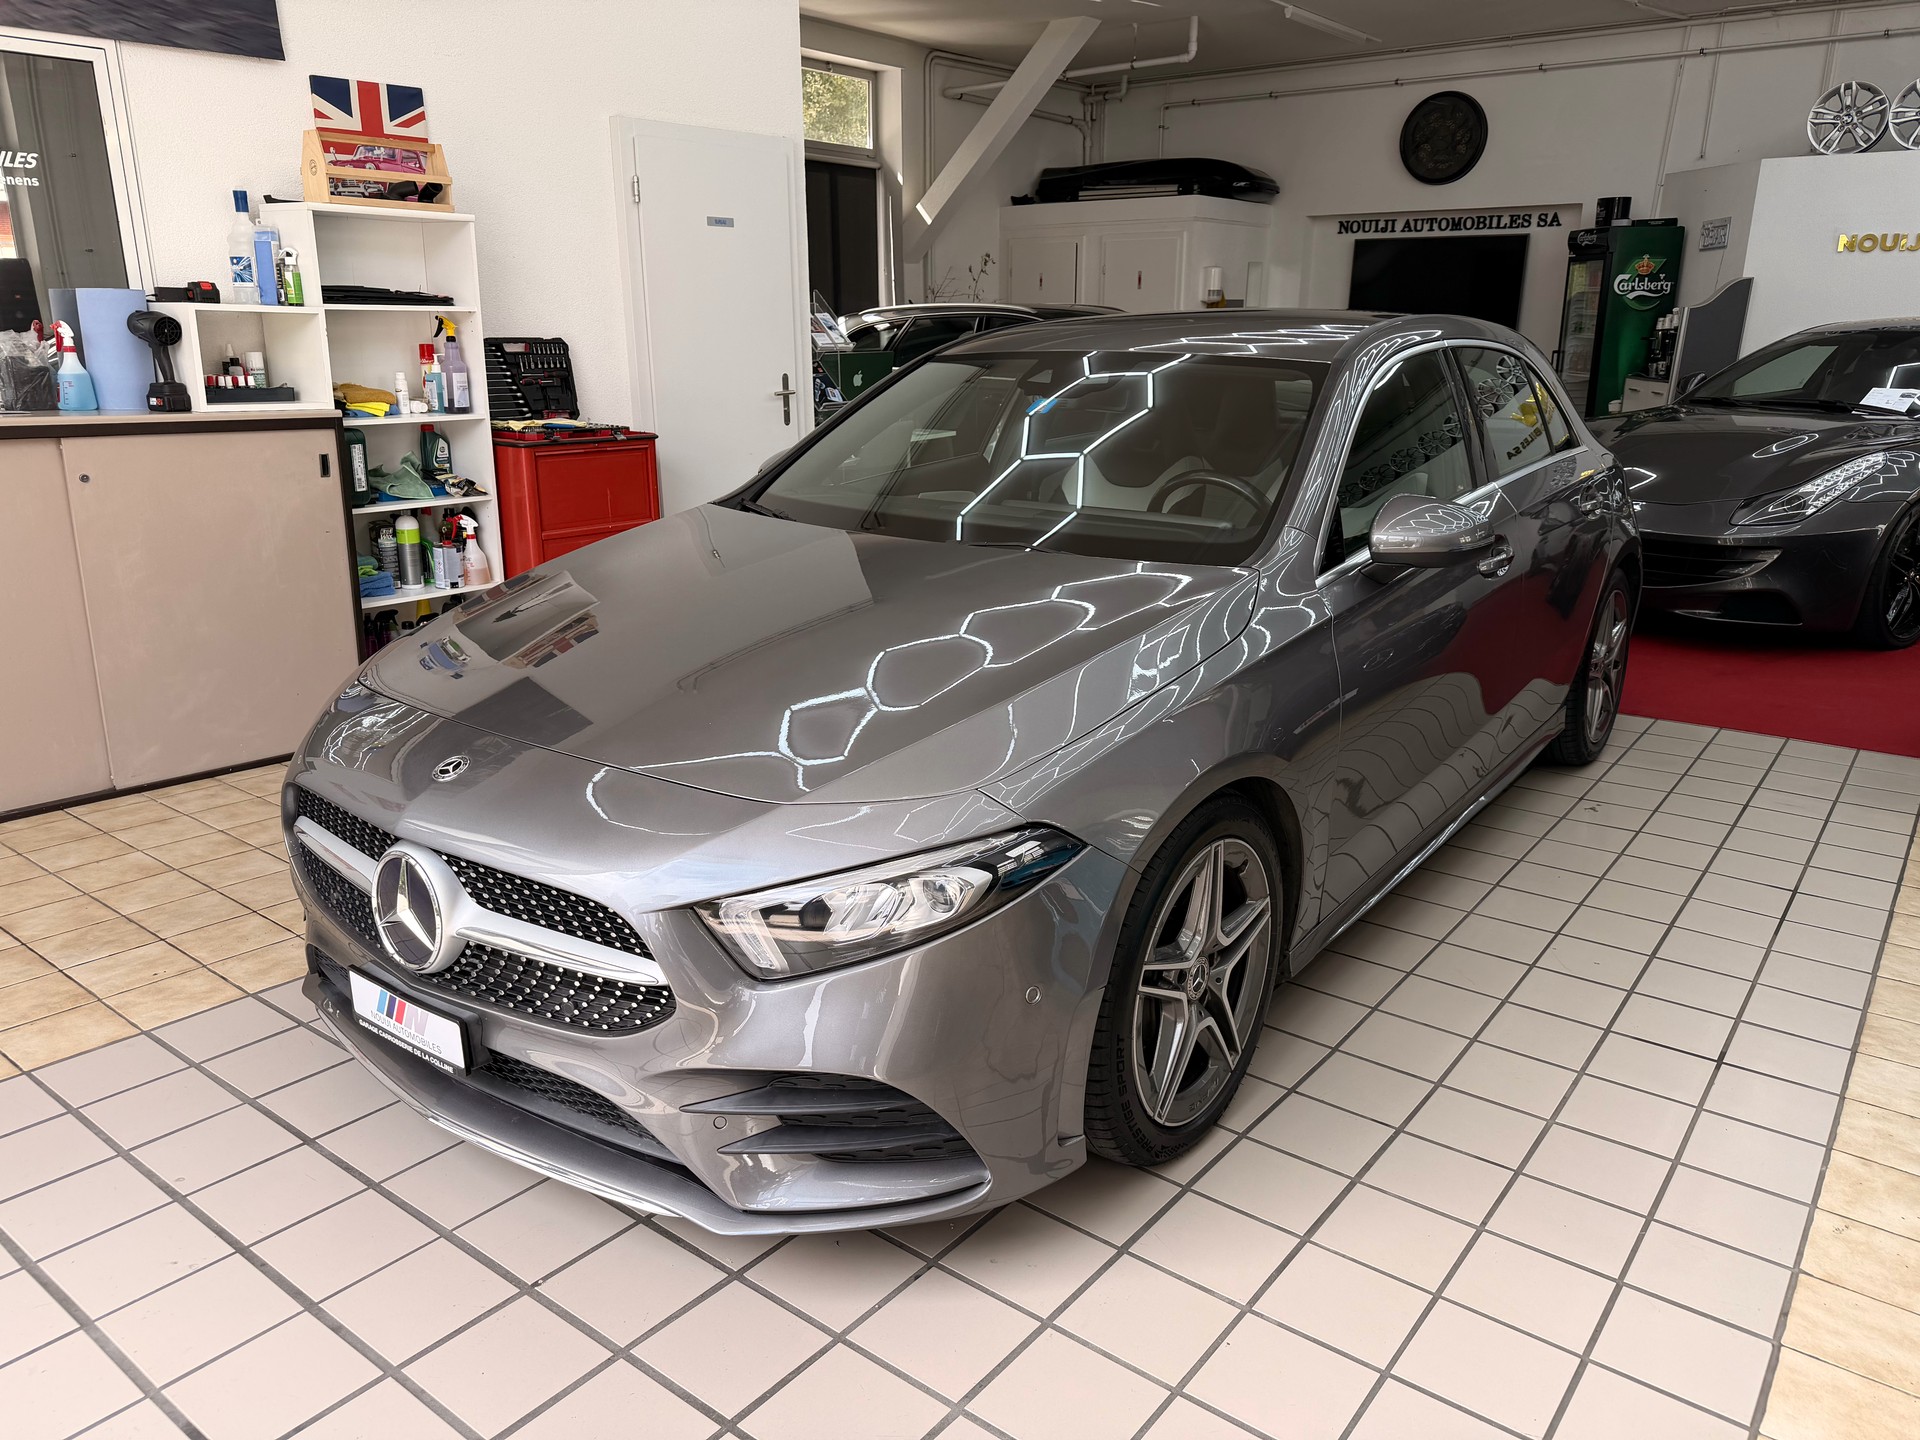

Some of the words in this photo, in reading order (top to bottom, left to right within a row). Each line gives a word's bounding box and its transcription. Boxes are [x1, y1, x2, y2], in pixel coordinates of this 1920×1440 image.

[1337, 218, 1398, 234] NOUIJI
[1400, 213, 1532, 234] AUTOMOBILES
[1536, 212, 1562, 227] SA
[1613, 273, 1671, 299] Carlsberg
[393, 1023, 442, 1055] AUTOMOBILES
[413, 1047, 422, 1058] DE
[421, 1052, 430, 1062] LA
[429, 1056, 454, 1074] COLLINE
[1115, 1034, 1128, 1097] SPORT
[1121, 1100, 1156, 1153] PRESTIGE
